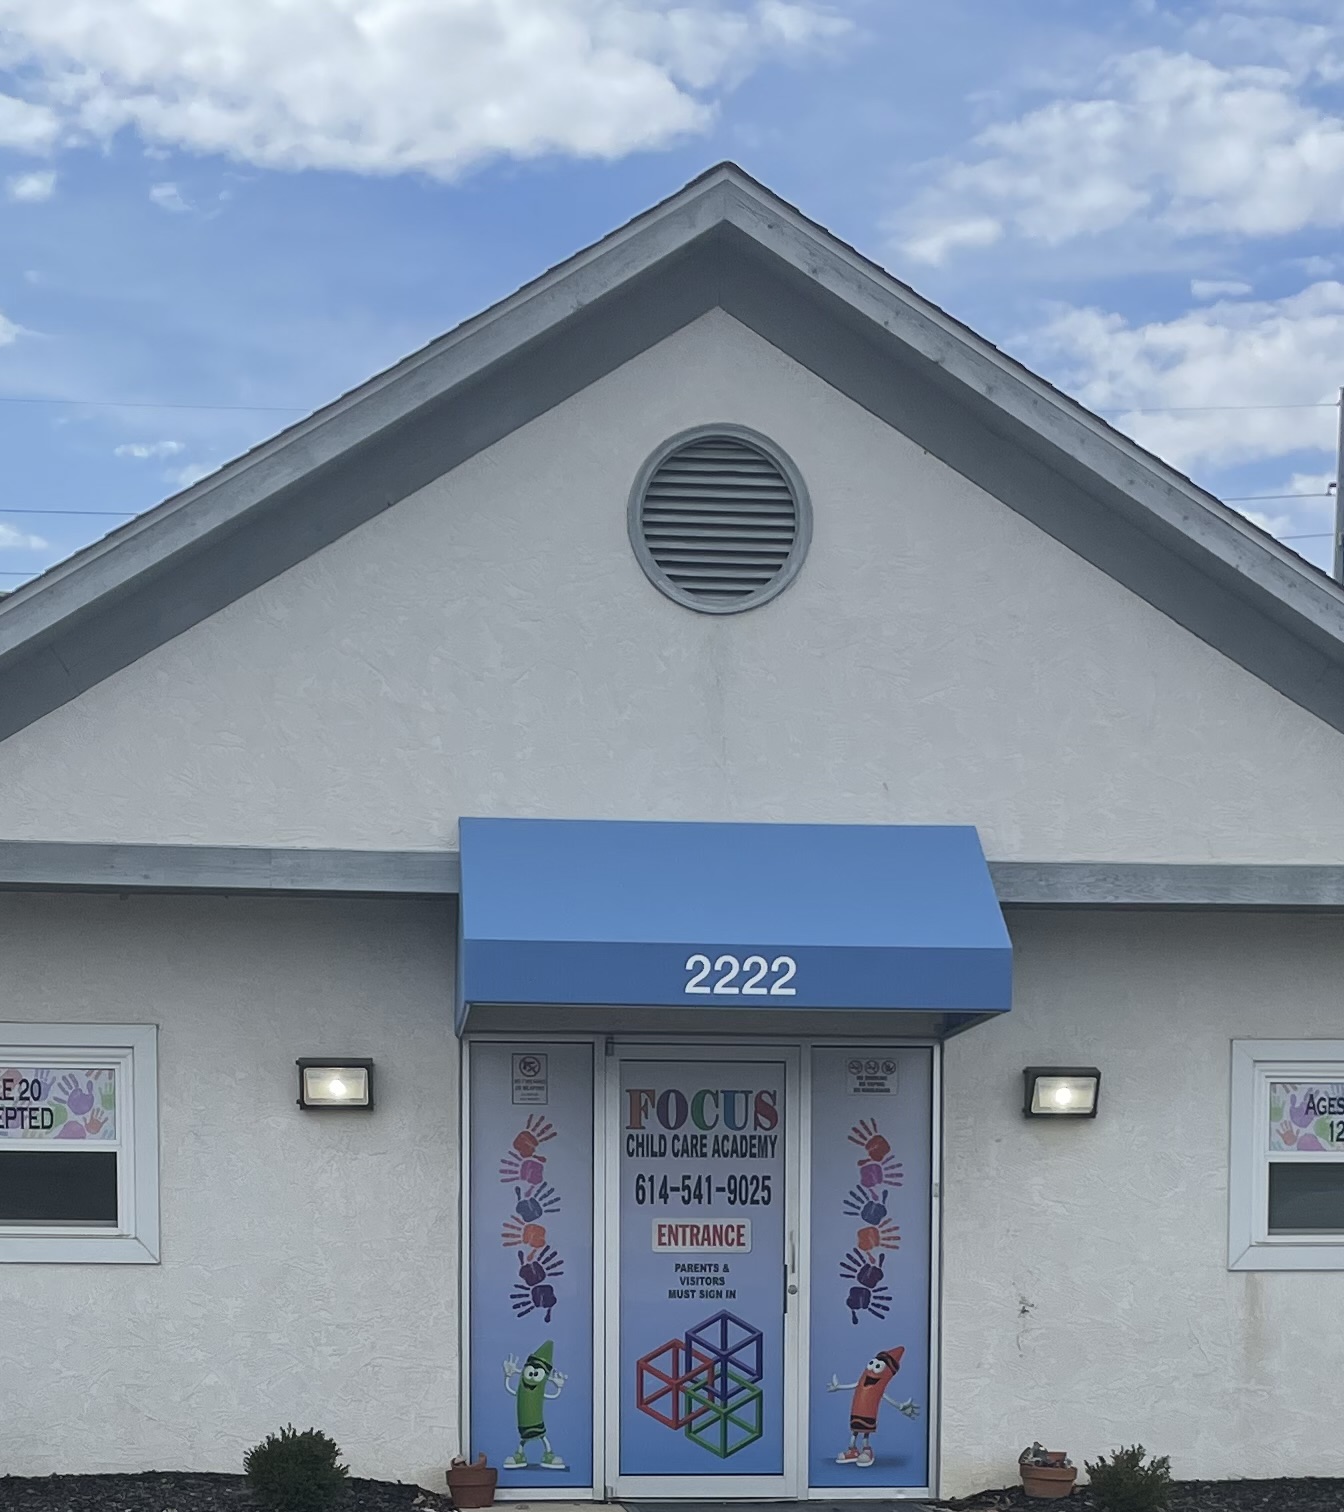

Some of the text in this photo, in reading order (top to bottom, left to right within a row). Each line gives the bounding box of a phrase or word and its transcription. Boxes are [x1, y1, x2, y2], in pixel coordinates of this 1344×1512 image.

[684, 954, 797, 996] 2222
[18, 1078, 42, 1102] 20
[625, 1088, 779, 1132] FOCUS
[626, 1133, 778, 1159] CHILD CARE ACADEMY
[635, 1173, 773, 1206] 614-541-9025
[657, 1223, 747, 1247] ENTRANCE
[674, 1263, 730, 1274] PARENTS &
[679, 1276, 726, 1287] VISITORS
[668, 1289, 737, 1299] MUST SIGN IN
